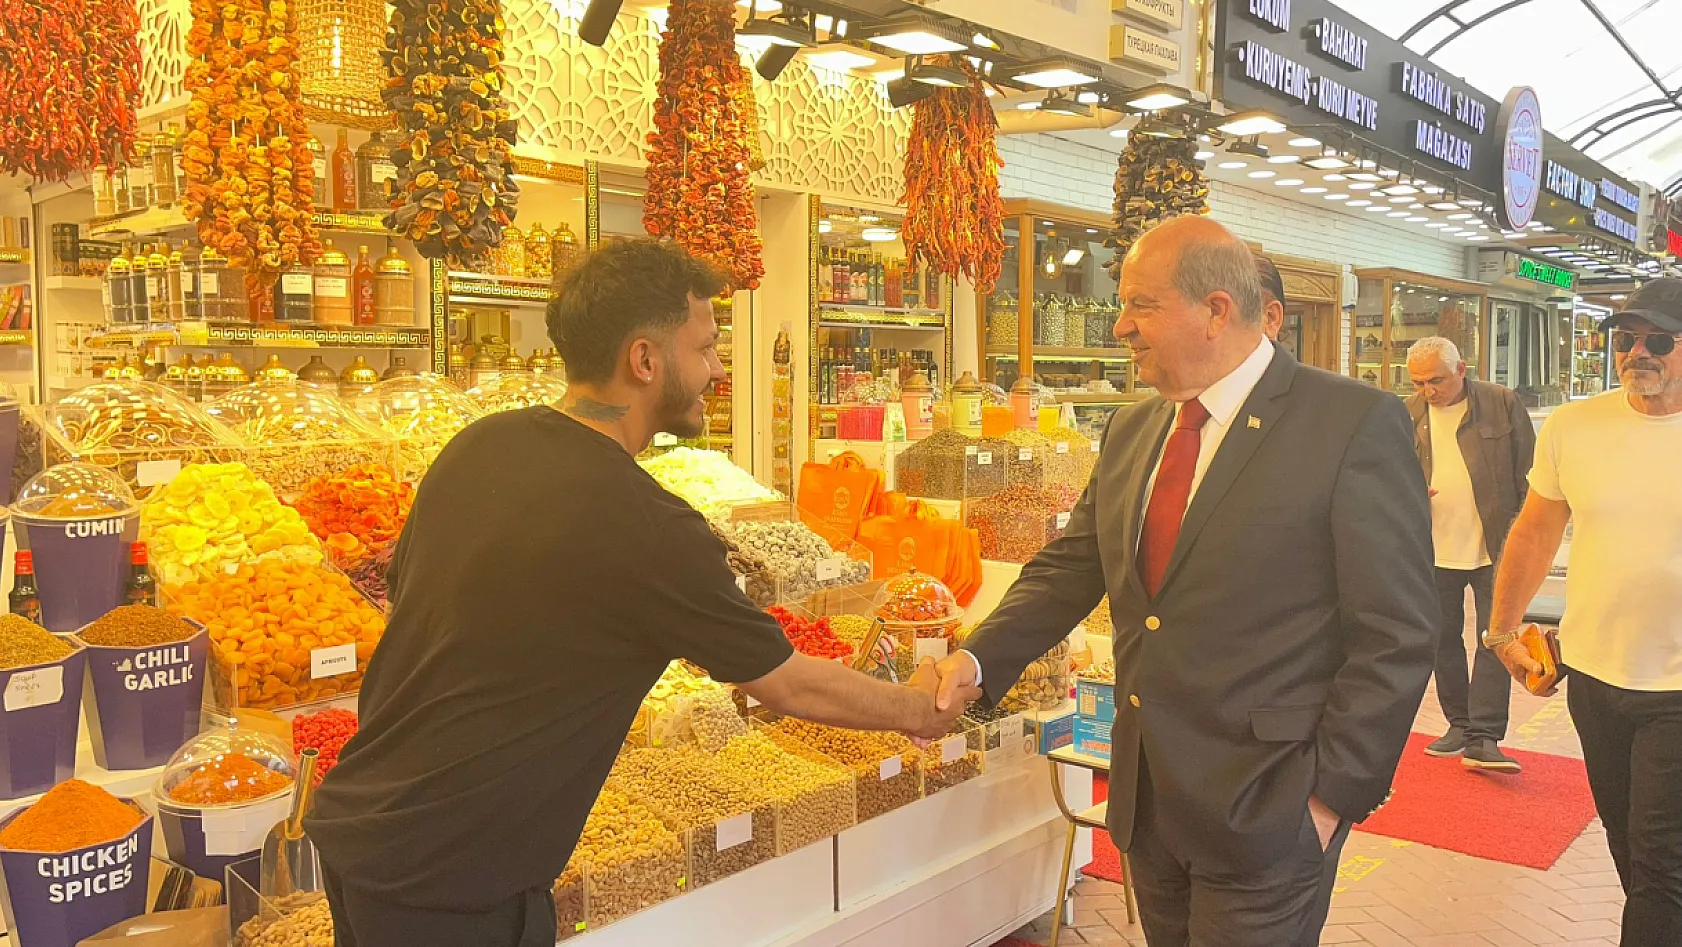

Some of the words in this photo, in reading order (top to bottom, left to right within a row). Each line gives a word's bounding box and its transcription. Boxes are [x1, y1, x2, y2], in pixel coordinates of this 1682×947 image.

[1321, 17, 1368, 70] BAHARAT
[1318, 75, 1346, 118] KURU
[1346, 88, 1378, 131] MEYVE
[1403, 61, 1451, 116] FABRİKA
[1456, 91, 1486, 135] SATIŞ
[1416, 119, 1472, 171] MAĞAZASI
[1507, 137, 1539, 181] SERVET
[65, 517, 125, 538] CUMIN
[124, 663, 194, 691] GARLIC
[135, 645, 189, 669] CHILI
[38, 833, 138, 878] CHICKEN
[49, 863, 133, 903] SPICES
